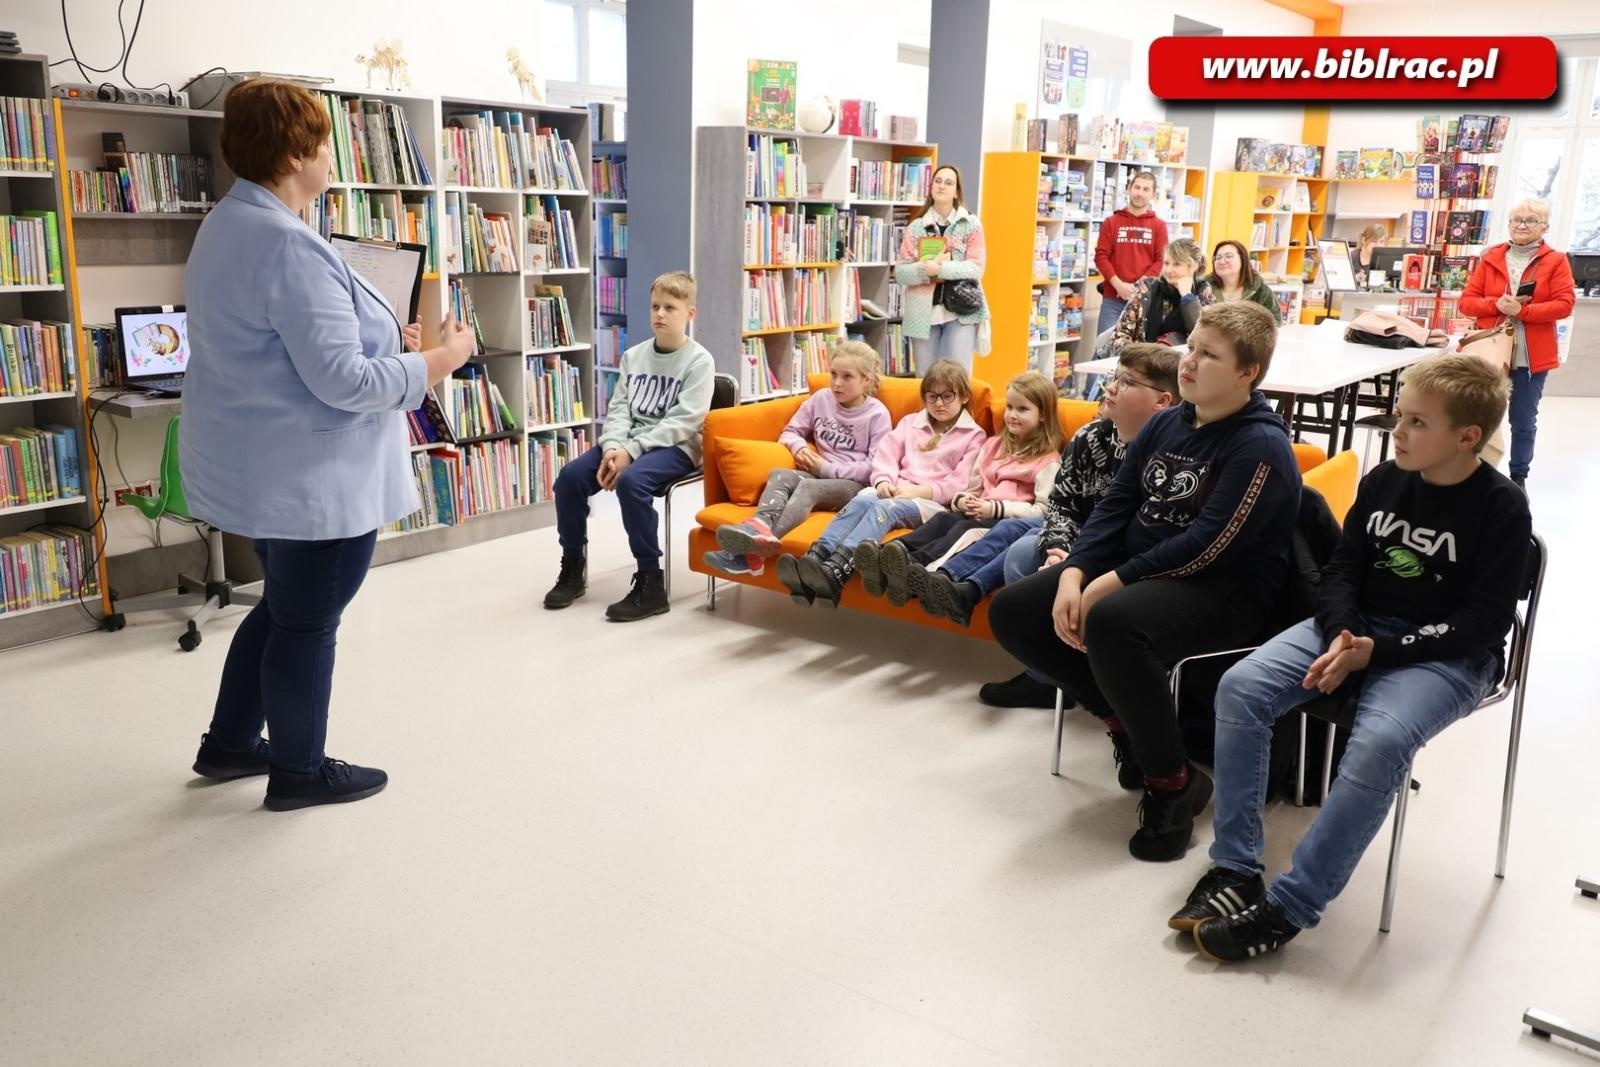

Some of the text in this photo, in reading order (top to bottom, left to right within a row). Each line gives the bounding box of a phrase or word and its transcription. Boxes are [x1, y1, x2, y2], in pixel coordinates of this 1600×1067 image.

[823, 417, 855, 436] CHOOSE
[1240, 465, 1269, 516] HOGWARTS
[1204, 521, 1239, 561] HOGWARTS
[1366, 510, 1458, 563] NASA
